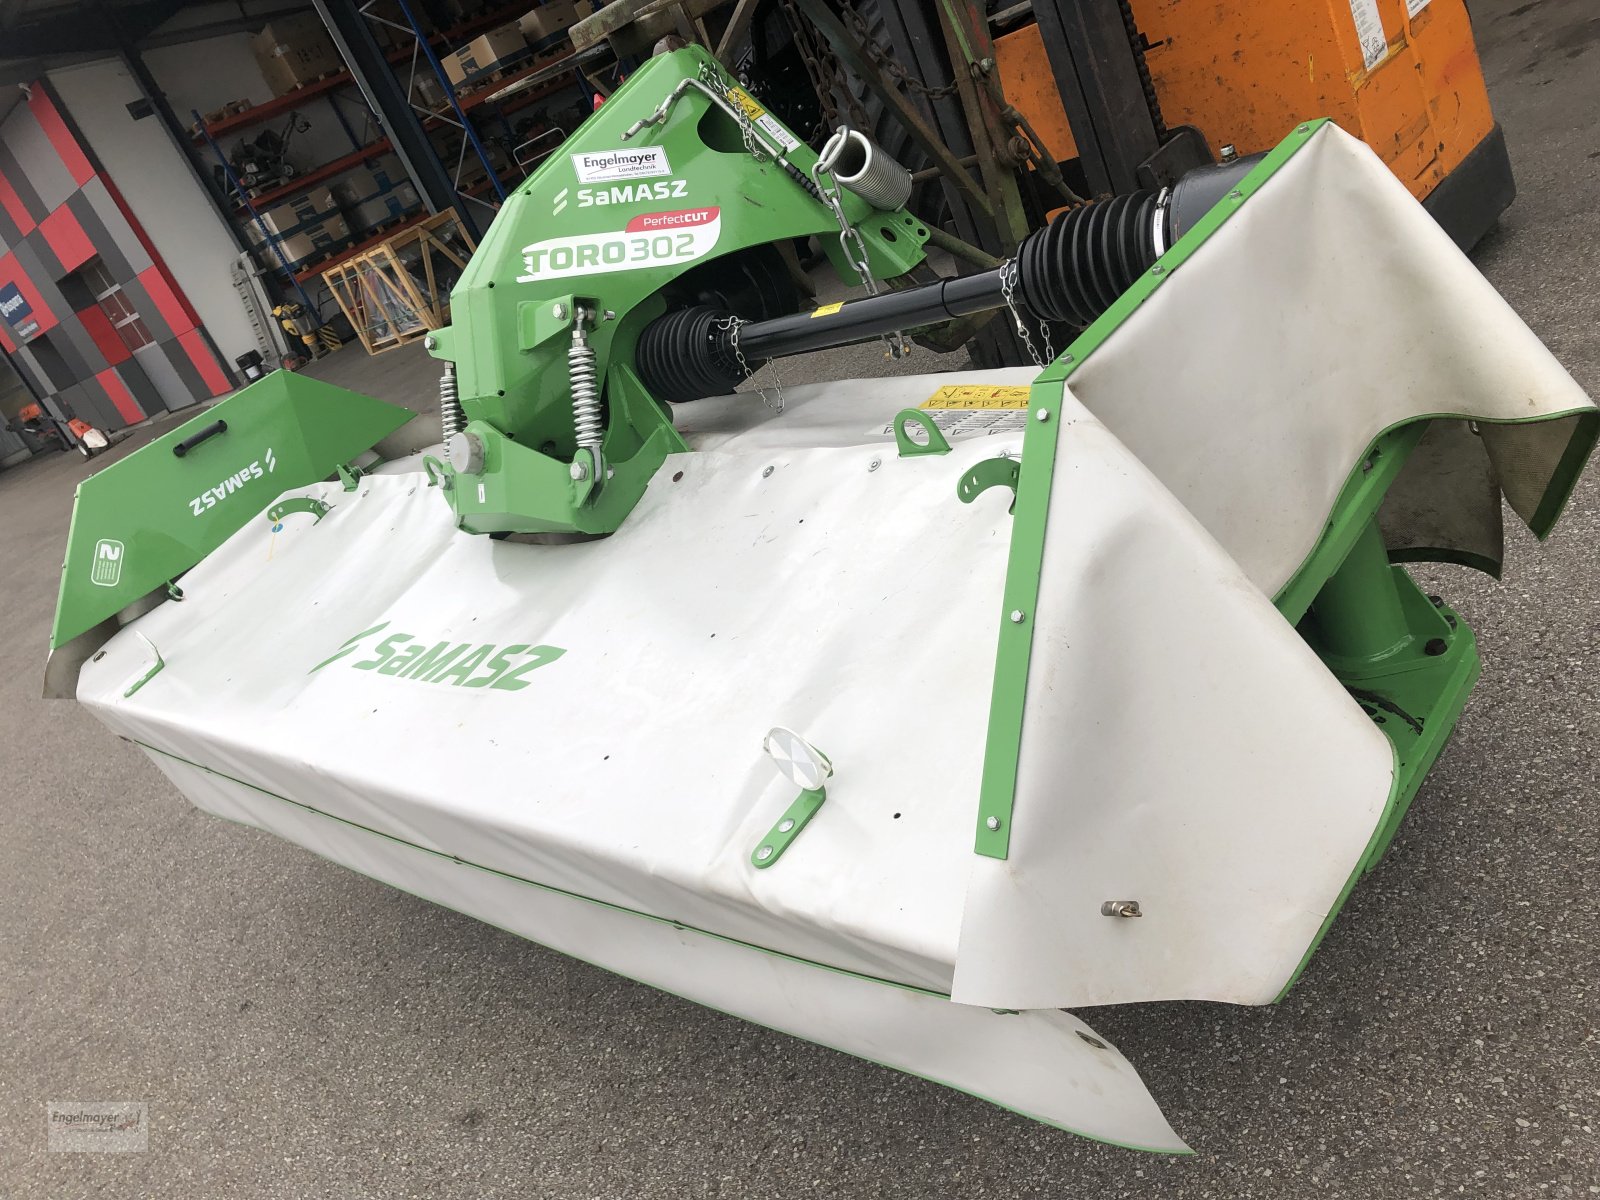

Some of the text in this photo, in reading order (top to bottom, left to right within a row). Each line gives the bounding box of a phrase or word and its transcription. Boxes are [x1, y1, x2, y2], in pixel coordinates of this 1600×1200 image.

[583, 153, 657, 169] Engelmayer
[618, 164, 657, 174] Landtechnik
[577, 179, 689, 208] SaMASZ
[643, 211, 709, 227] PerfectCUT
[189, 460, 264, 516] SaMASZ
[351, 632, 568, 692] SaMASZ
